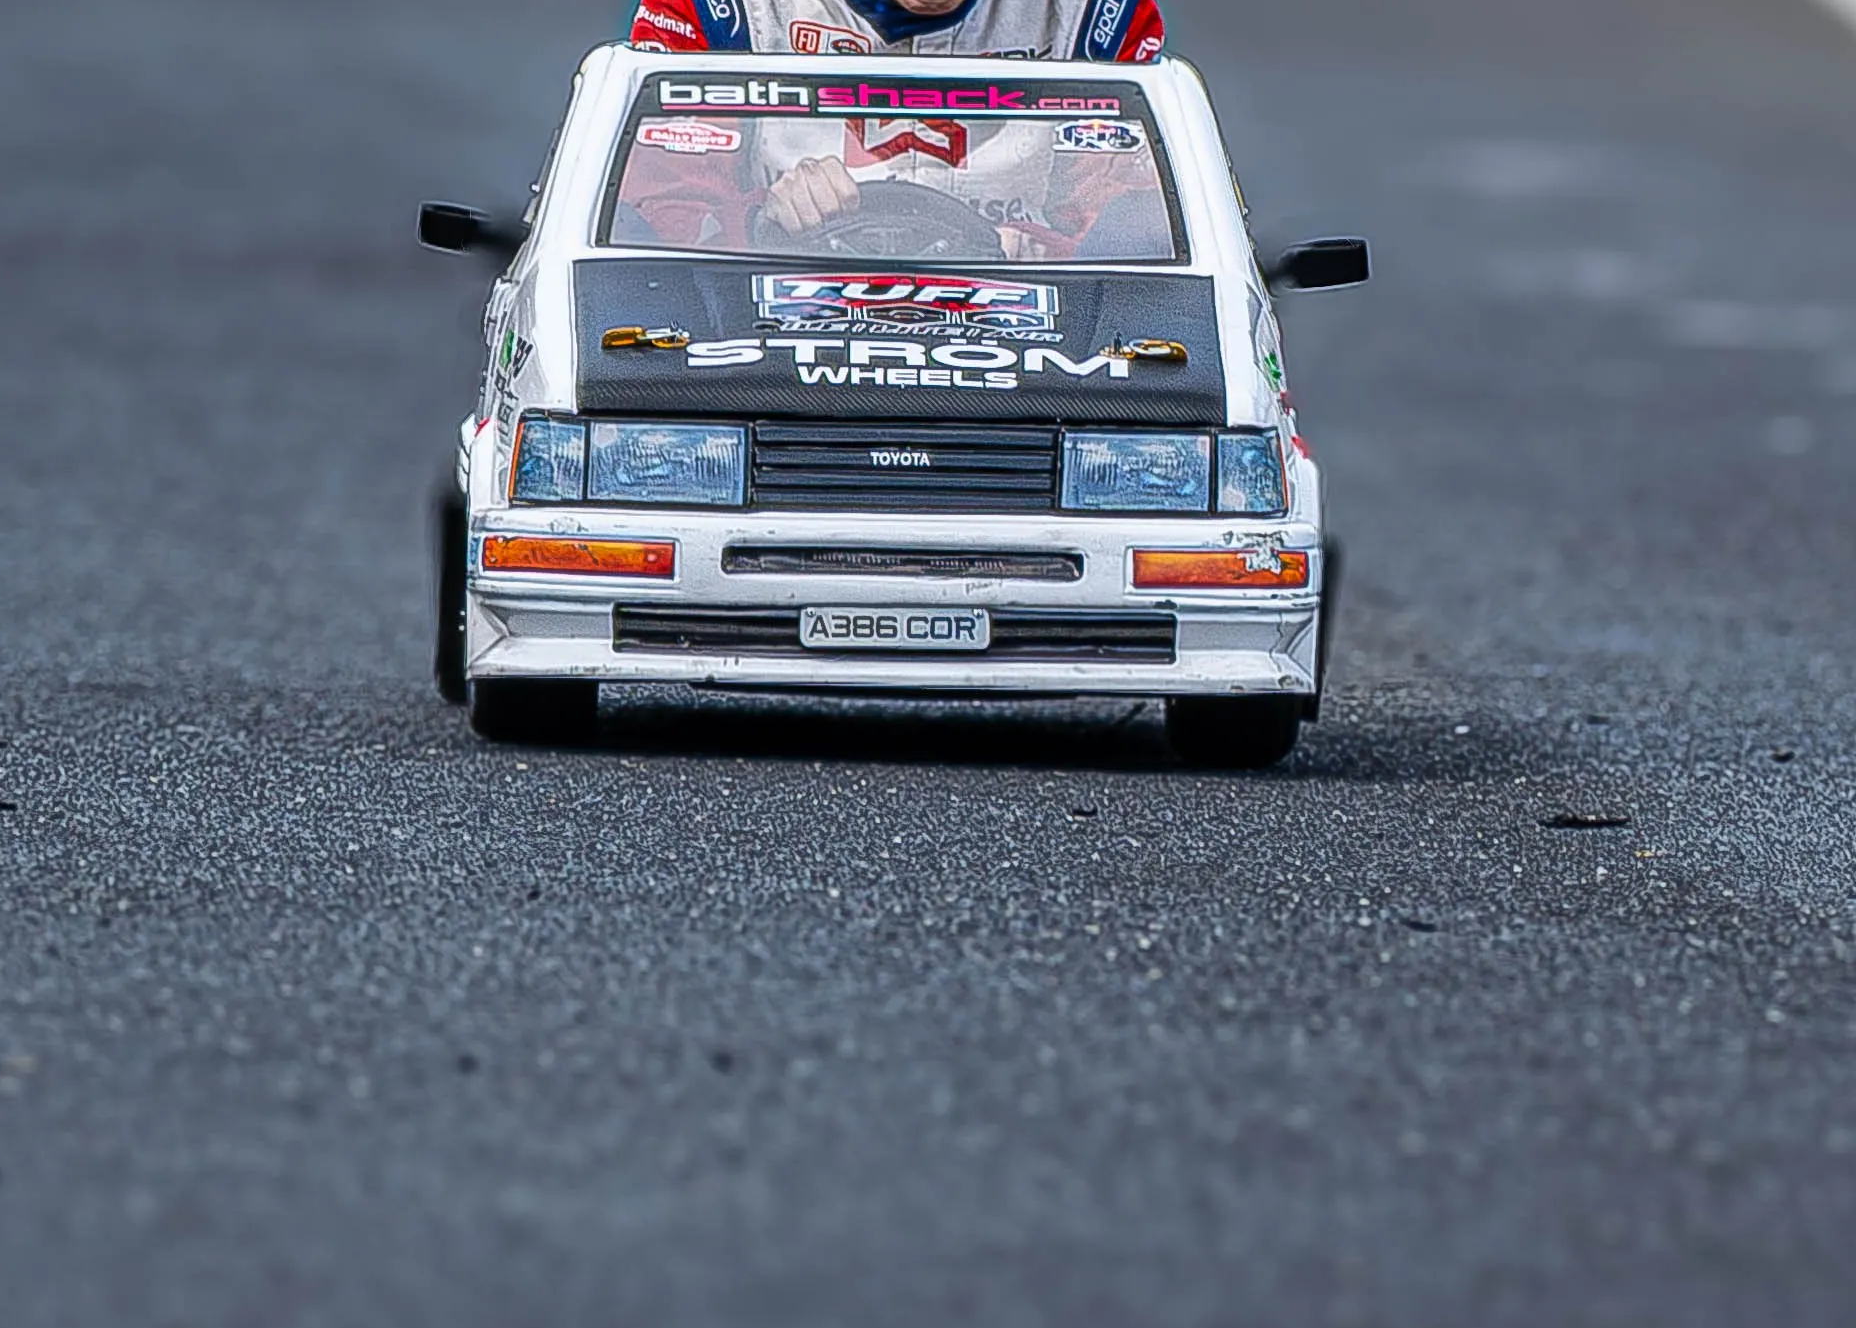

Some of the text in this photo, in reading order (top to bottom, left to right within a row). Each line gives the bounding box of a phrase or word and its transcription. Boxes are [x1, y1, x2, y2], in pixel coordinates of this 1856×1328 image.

[783, 280, 1029, 304] TUFF
[687, 338, 1129, 378] STRÖM
[798, 366, 1018, 389] WHEELS
[870, 451, 931, 467] TOYOTA
[809, 615, 976, 640] A386 COR
